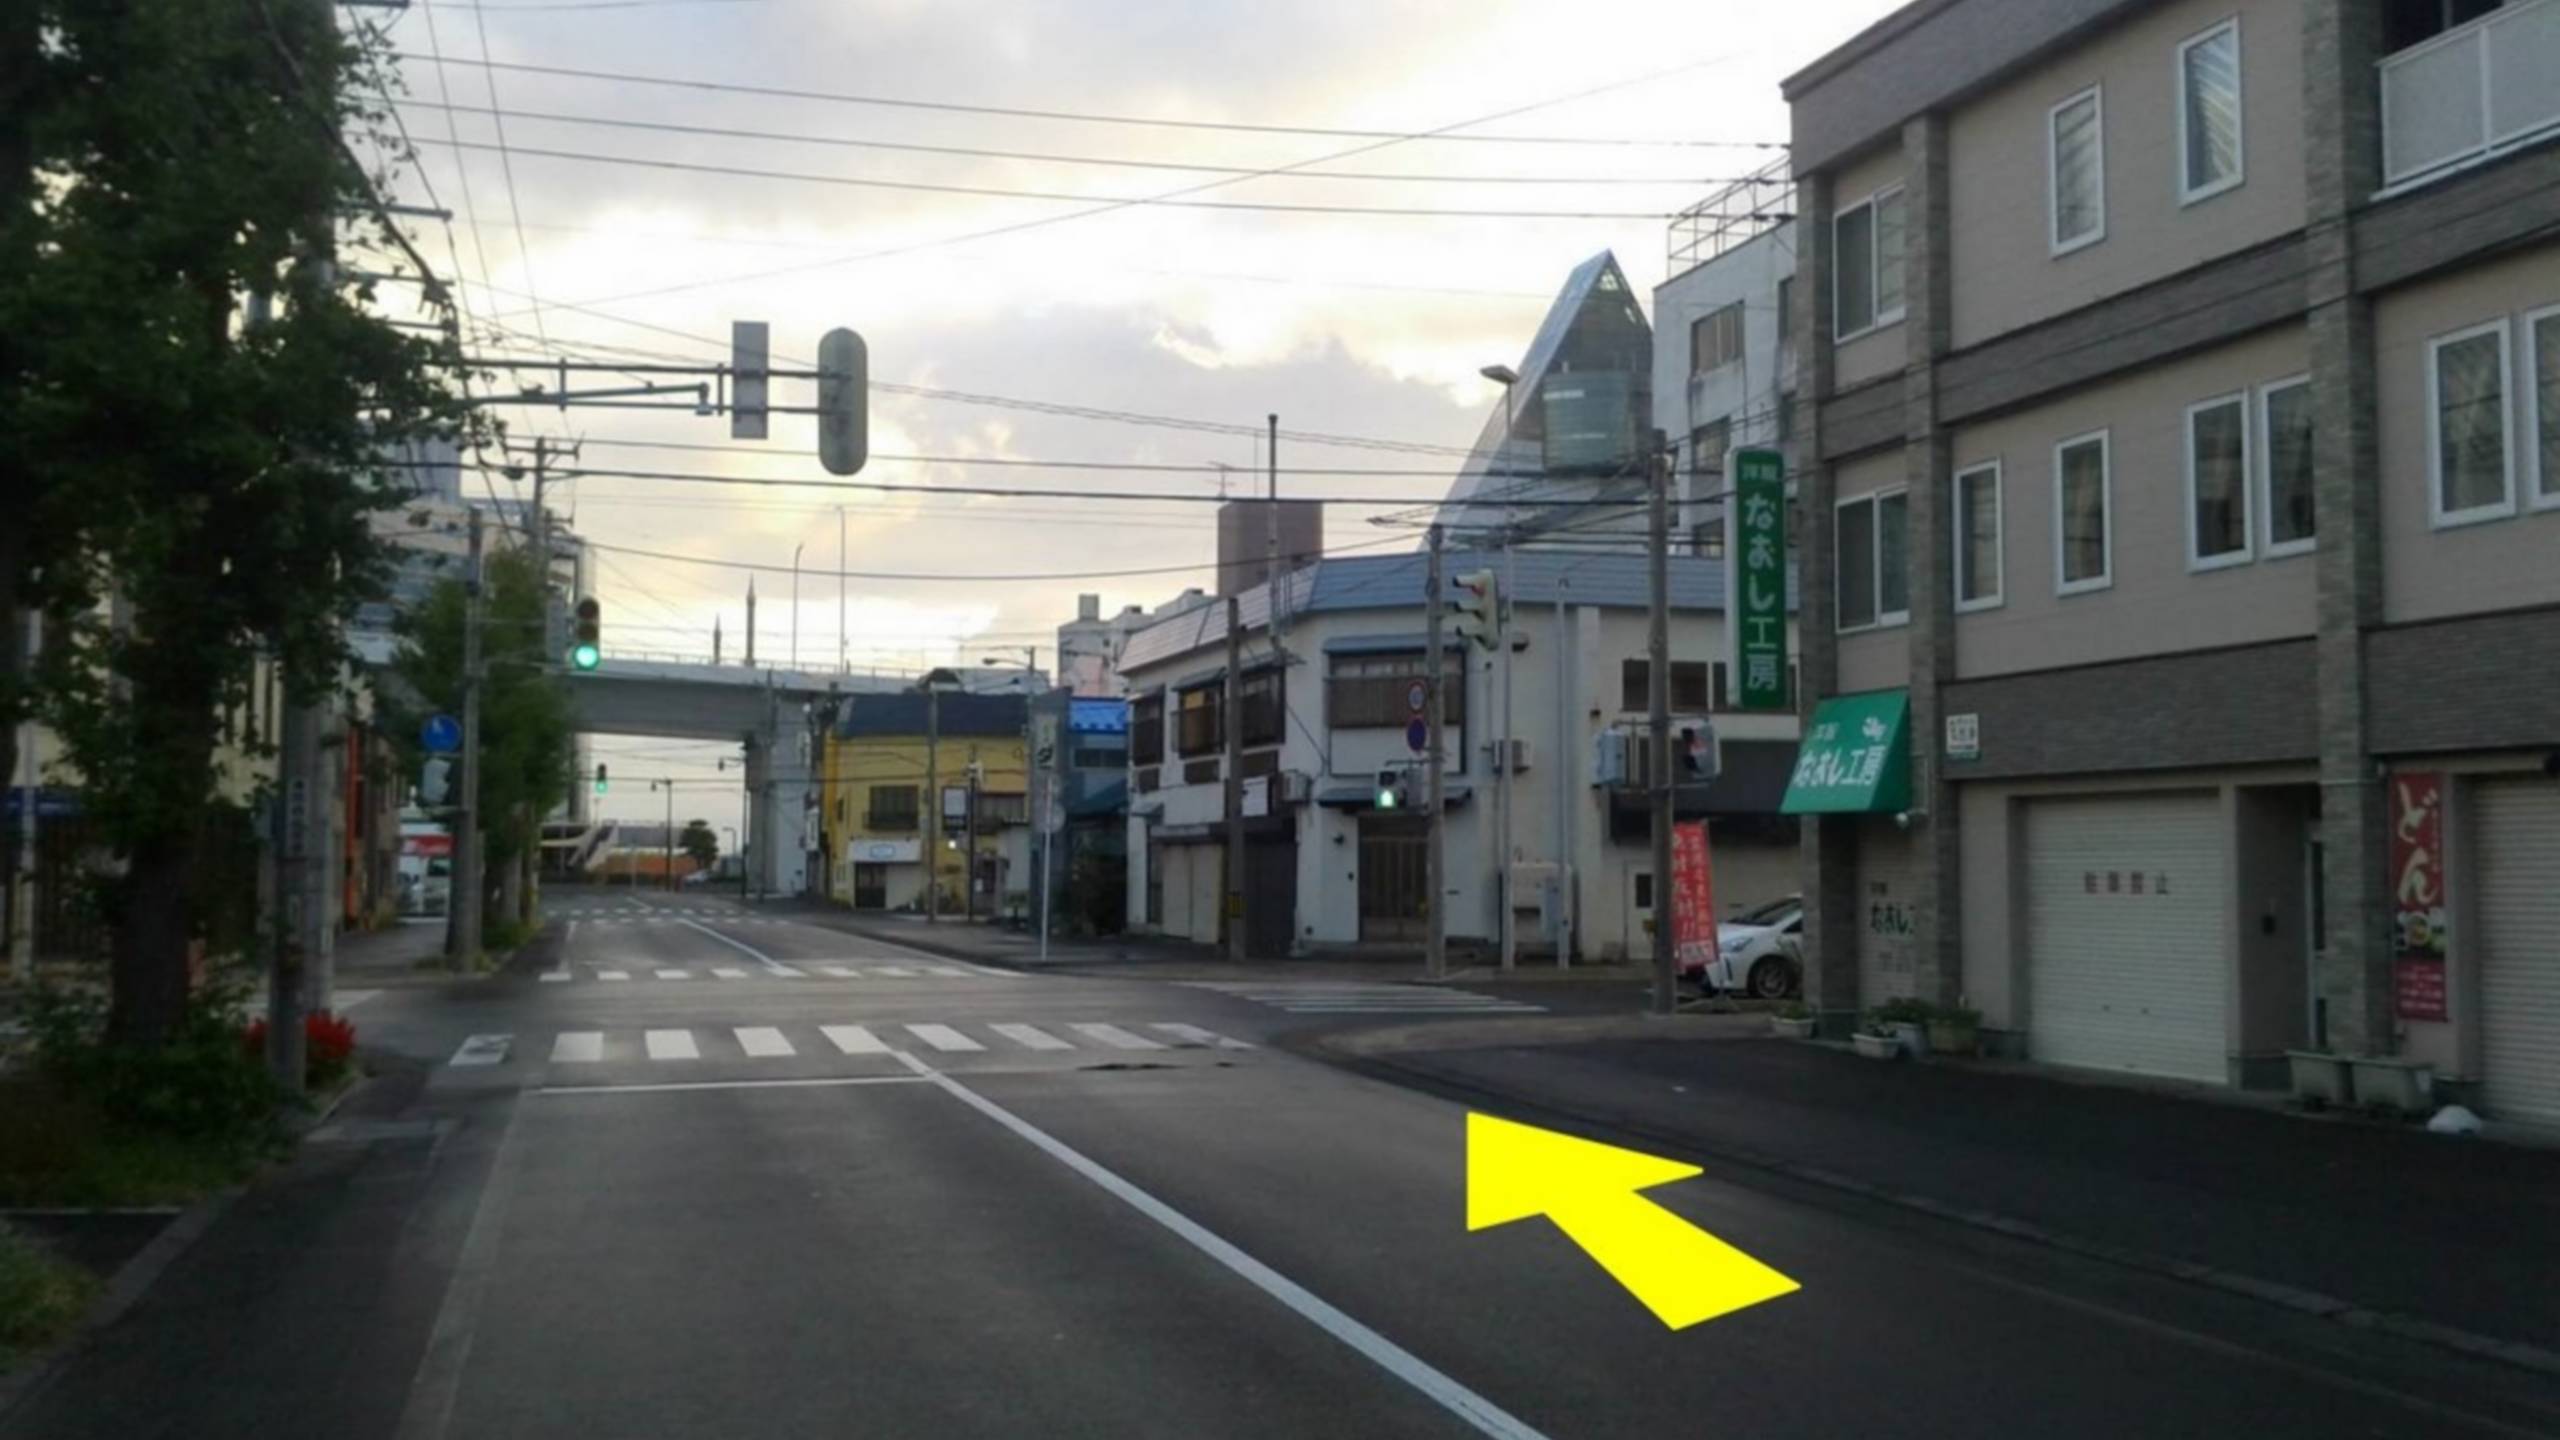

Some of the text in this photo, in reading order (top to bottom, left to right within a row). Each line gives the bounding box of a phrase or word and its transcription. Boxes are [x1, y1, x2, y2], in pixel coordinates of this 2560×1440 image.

[1744, 494, 1777, 690] なおし工房
[1793, 745, 1886, 787] なおし工房
[2398, 781, 2439, 906] どん
